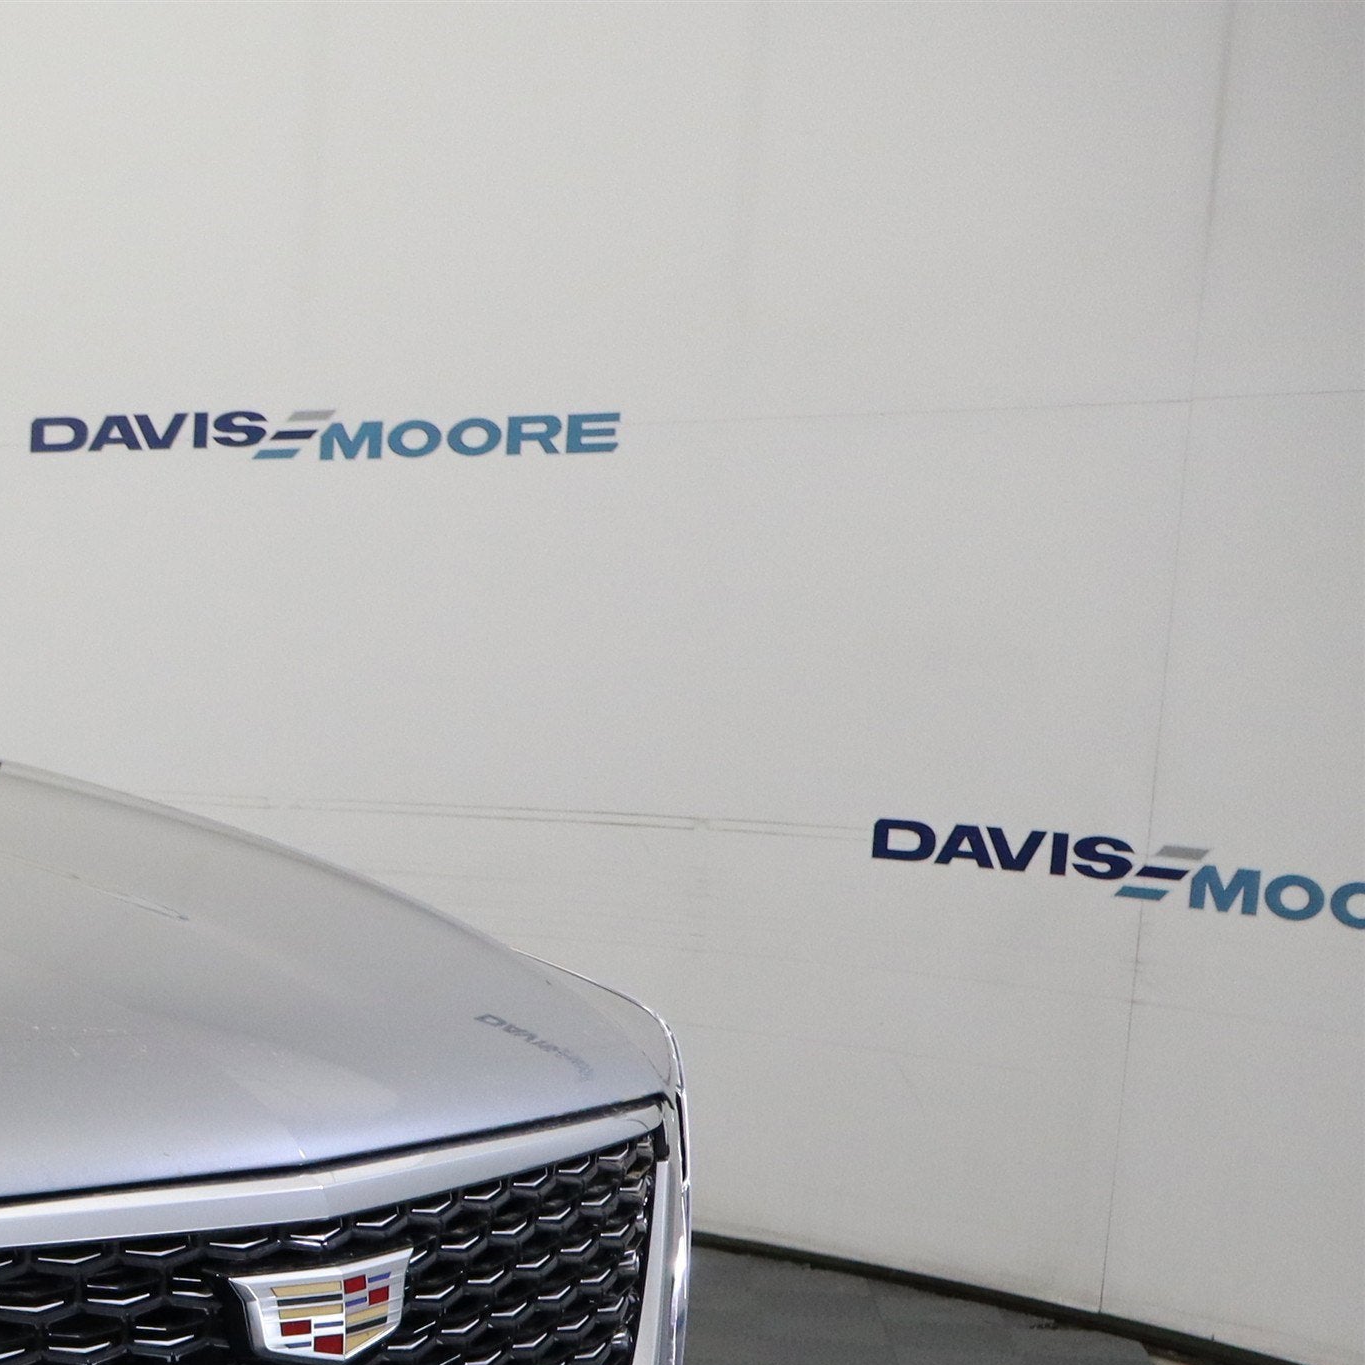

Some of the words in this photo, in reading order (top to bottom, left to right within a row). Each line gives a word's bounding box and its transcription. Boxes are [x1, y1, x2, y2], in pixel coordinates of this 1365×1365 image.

[30, 410, 269, 453] DAVIS
[319, 412, 621, 460] MOORE
[871, 818, 1136, 880] DAVIS
